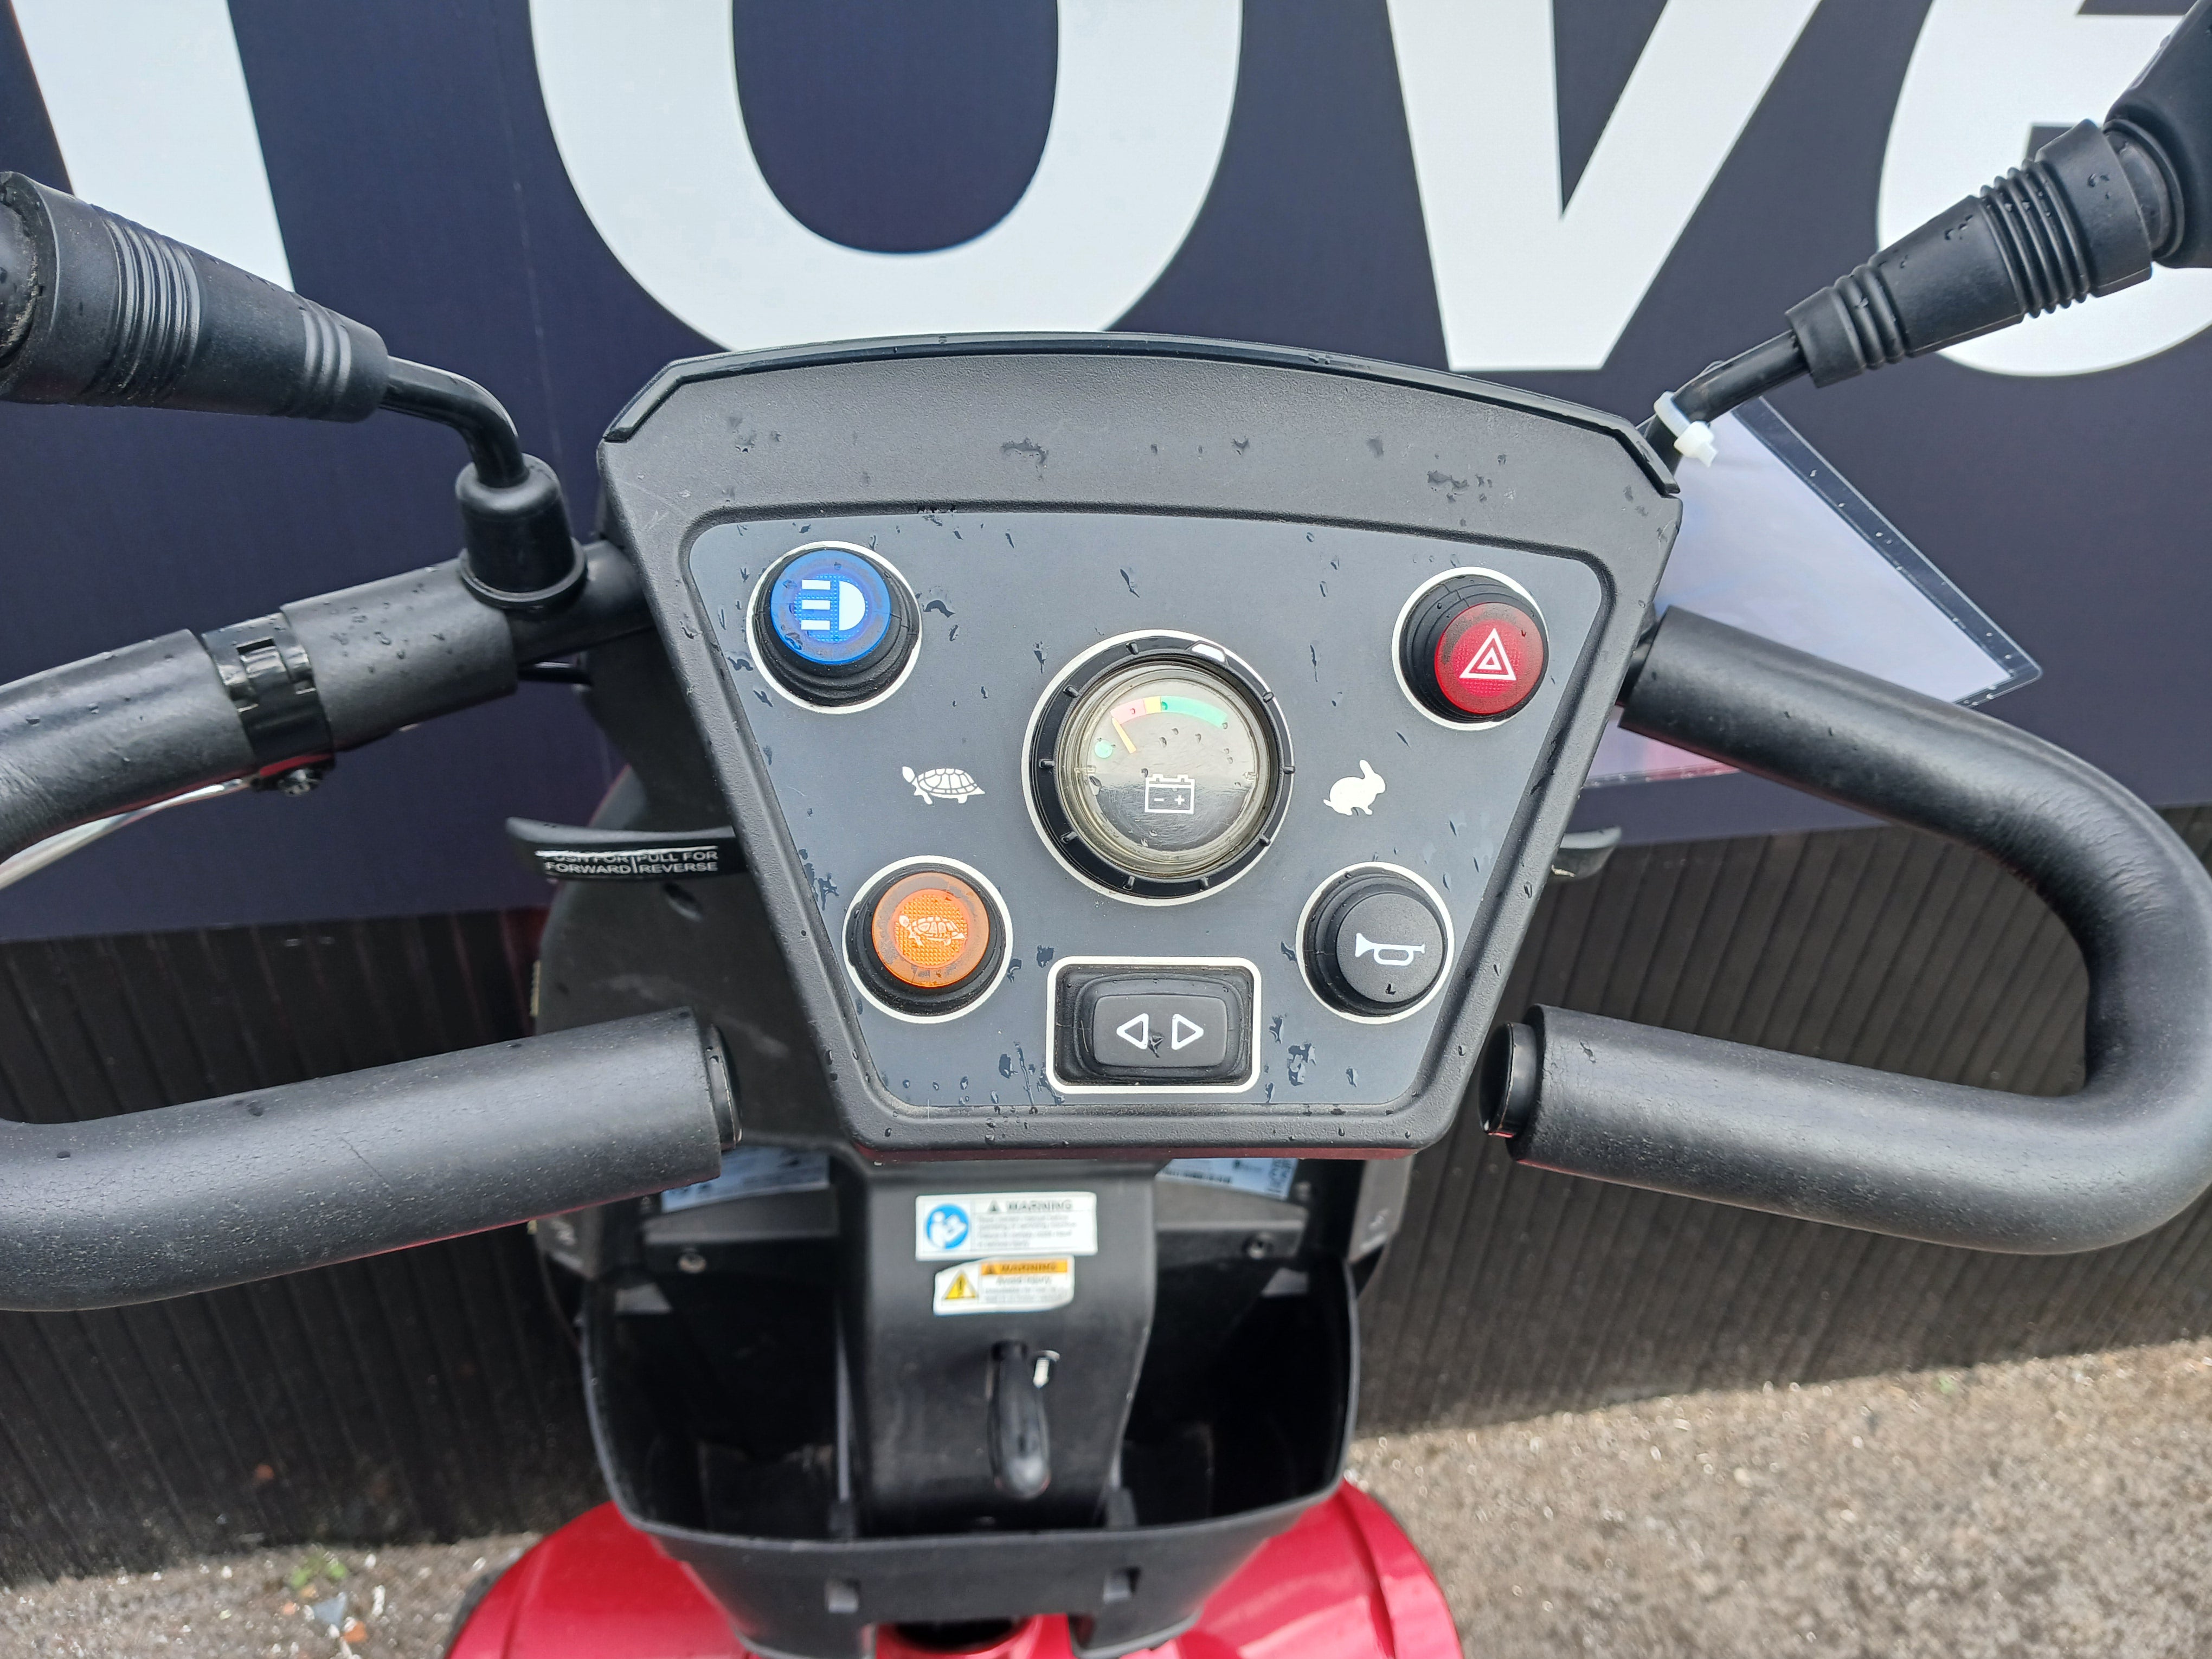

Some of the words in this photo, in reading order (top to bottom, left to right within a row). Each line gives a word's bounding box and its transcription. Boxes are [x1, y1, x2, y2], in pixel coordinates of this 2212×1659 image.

[637, 852, 678, 863] PULL
[682, 851, 718, 861] FOR
[544, 861, 631, 874] FORWARD
[639, 861, 718, 874] REVERSE
[1006, 1199, 1073, 1212] WARNING
